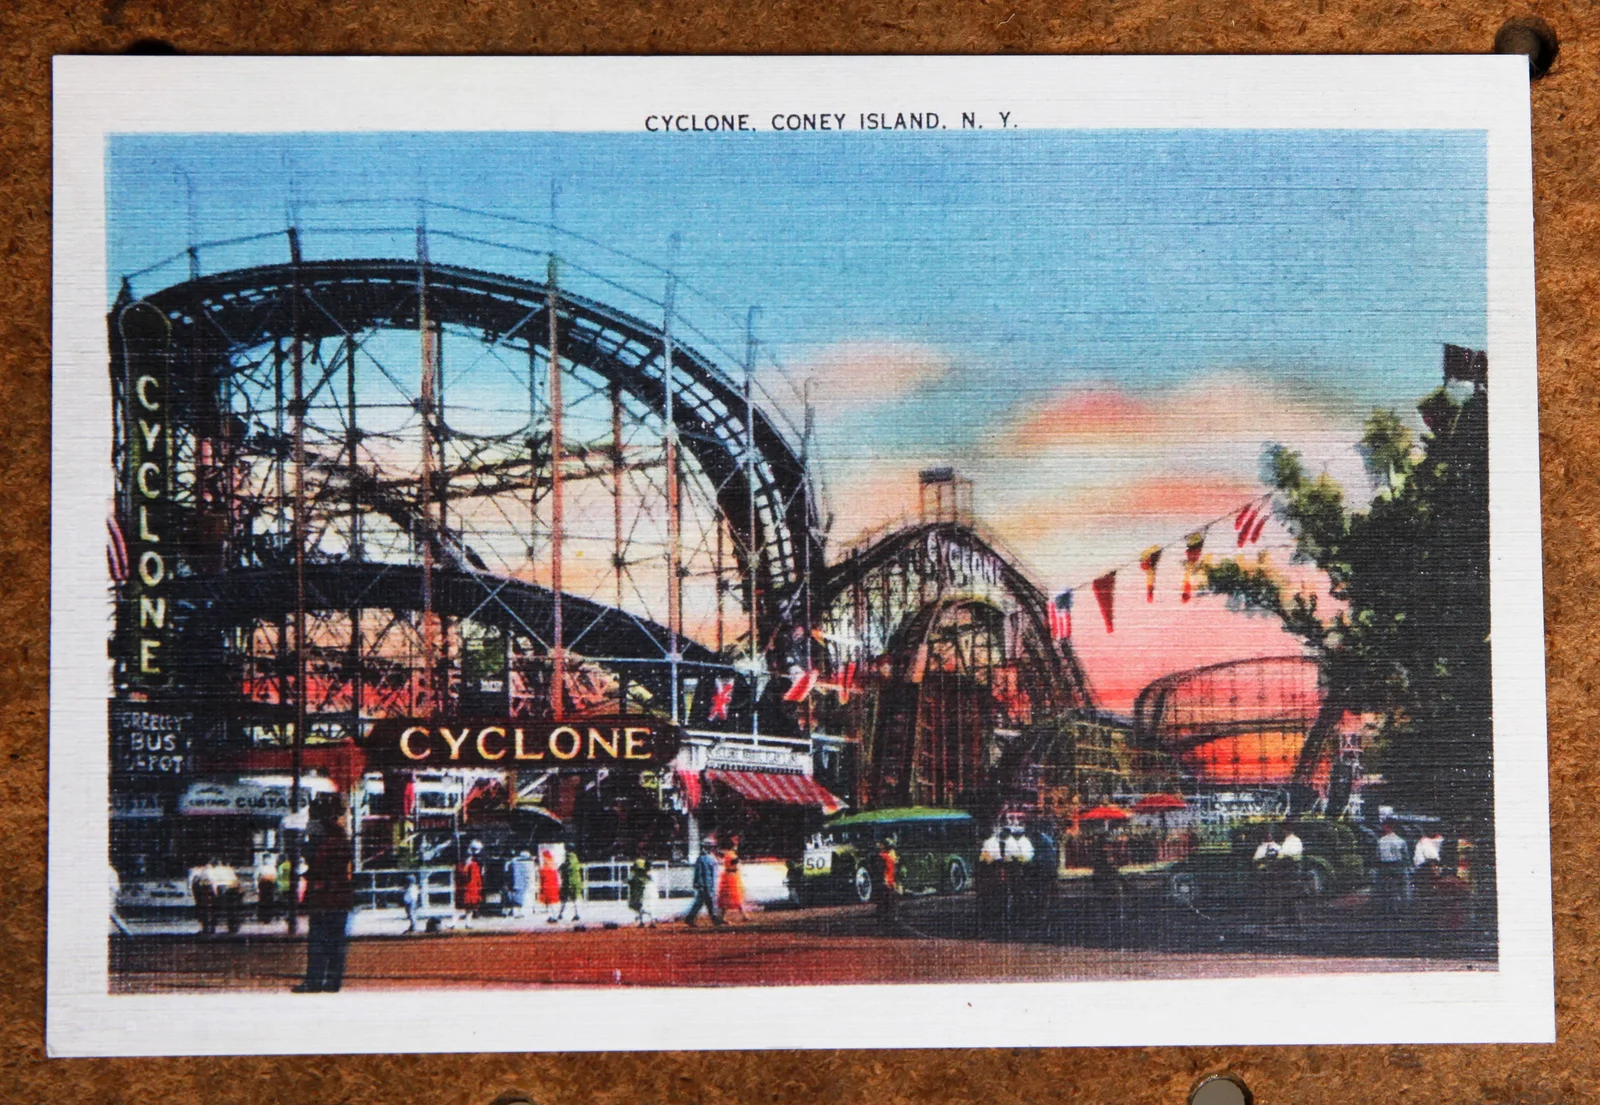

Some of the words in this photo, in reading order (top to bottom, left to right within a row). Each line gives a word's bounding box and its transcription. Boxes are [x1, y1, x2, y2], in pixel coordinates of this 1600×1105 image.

[771, 113, 846, 131] CONEY
[962, 111, 983, 130] N.
[999, 110, 1018, 129] Y.
[136, 375, 165, 674] CYCLONE
[130, 732, 177, 751] BUS
[399, 725, 653, 760] CYCLONE
[235, 796, 307, 809] CUSTAD
